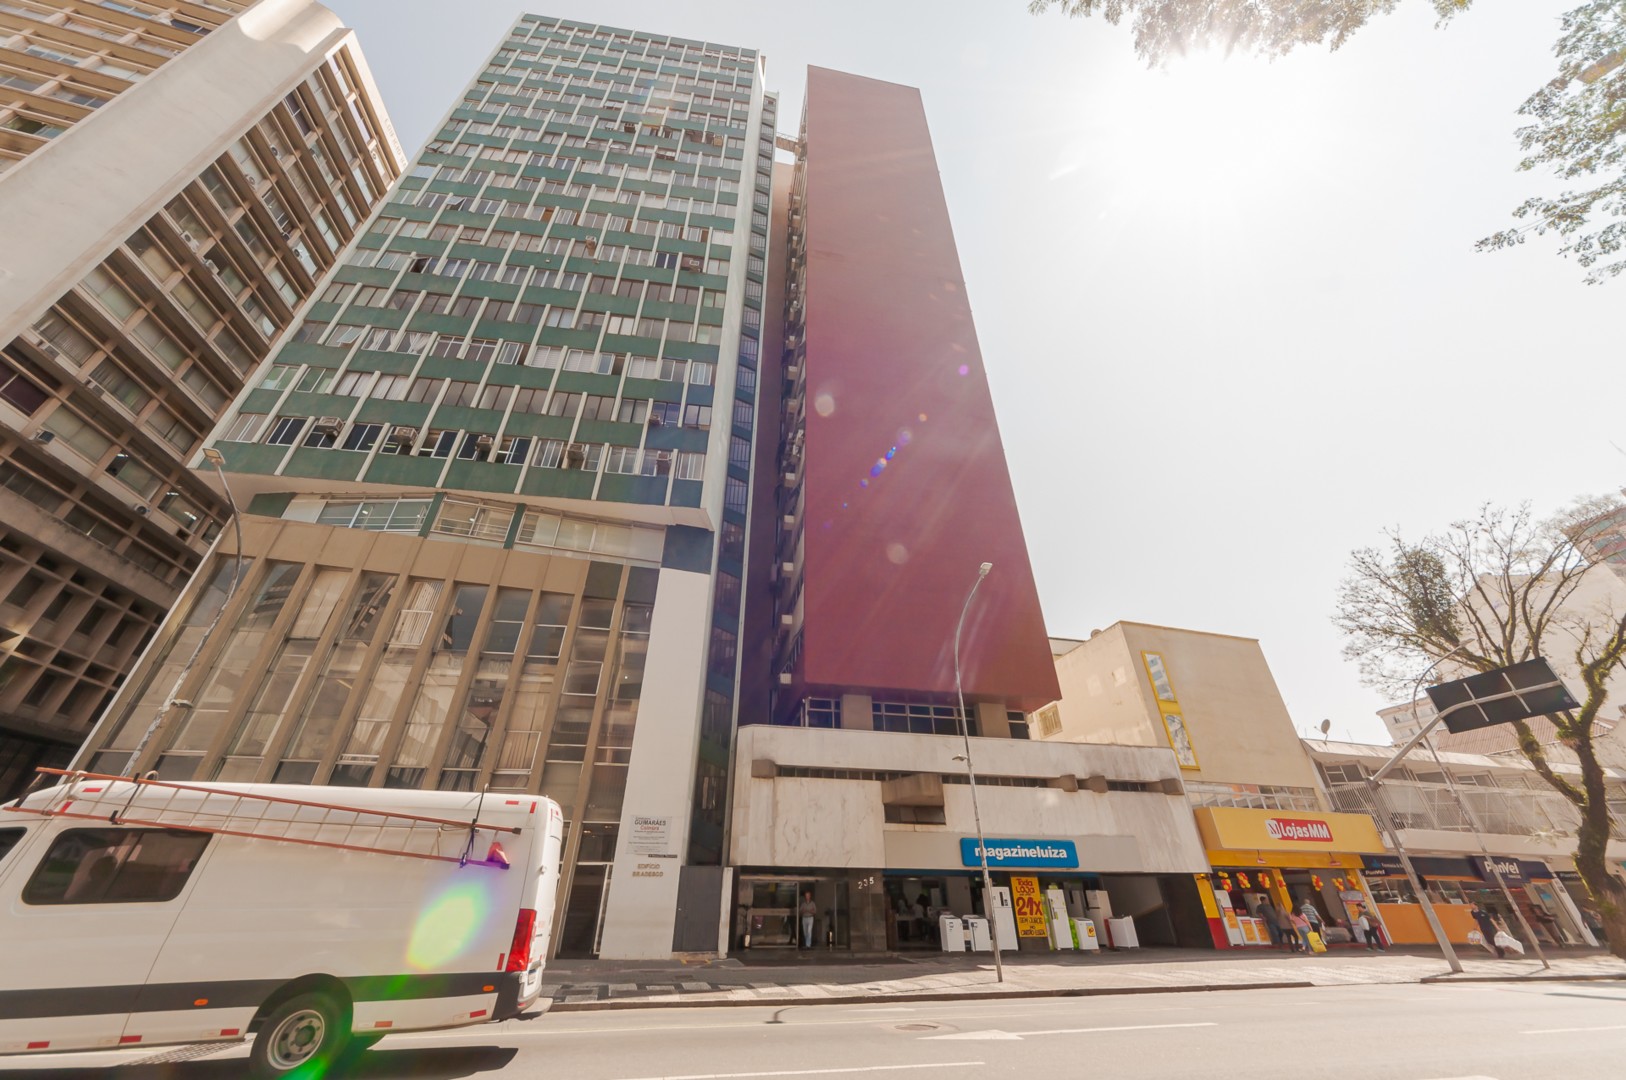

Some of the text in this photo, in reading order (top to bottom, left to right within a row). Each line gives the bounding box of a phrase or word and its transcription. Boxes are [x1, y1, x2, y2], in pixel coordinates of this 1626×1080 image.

[1279, 822, 1331, 840] LojasMM
[974, 845, 1068, 860] magazineluiza
[858, 876, 874, 889] 235
